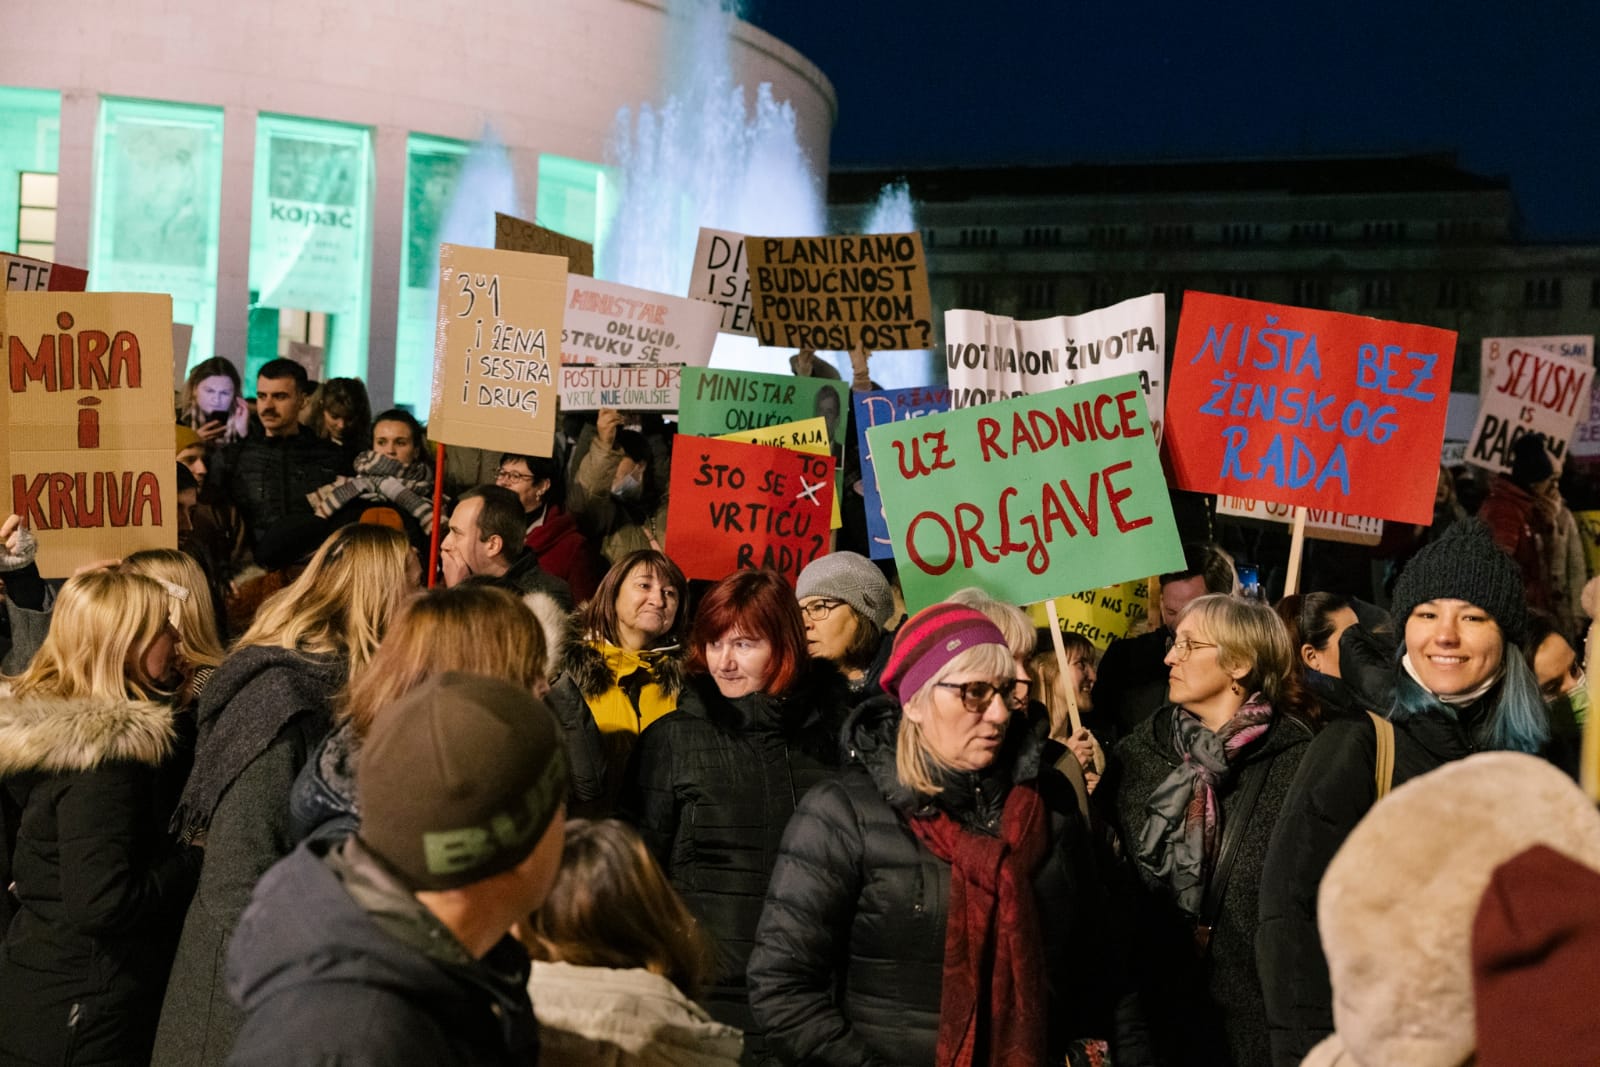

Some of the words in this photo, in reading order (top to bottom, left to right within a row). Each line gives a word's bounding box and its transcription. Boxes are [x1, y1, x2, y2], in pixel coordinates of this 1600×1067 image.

[763, 235, 915, 264] PLANIRAMO
[568, 288, 669, 326] MINISTAR
[761, 294, 914, 322] POVRATKOM
[637, 345, 662, 362] SE
[1190, 314, 1323, 381] NIŠTA
[1356, 343, 1440, 402] BEZ
[479, 355, 551, 385] SESTRA
[563, 367, 648, 389] POŠTUJTE
[1497, 348, 1587, 418] SEXISM
[478, 385, 538, 416] DRUG
[600, 390, 621, 406] NIJE
[696, 373, 797, 405] MINISTAR
[1199, 369, 1401, 446] ŽENSKOG
[1519, 405, 1535, 424] IS
[891, 428, 956, 480] UZ
[977, 390, 1145, 462] RADNICE
[693, 454, 746, 490] ŠTO
[757, 469, 787, 496] SE
[797, 454, 828, 478] TO
[1219, 424, 1351, 496] RADA
[12, 471, 163, 531] KRUVA
